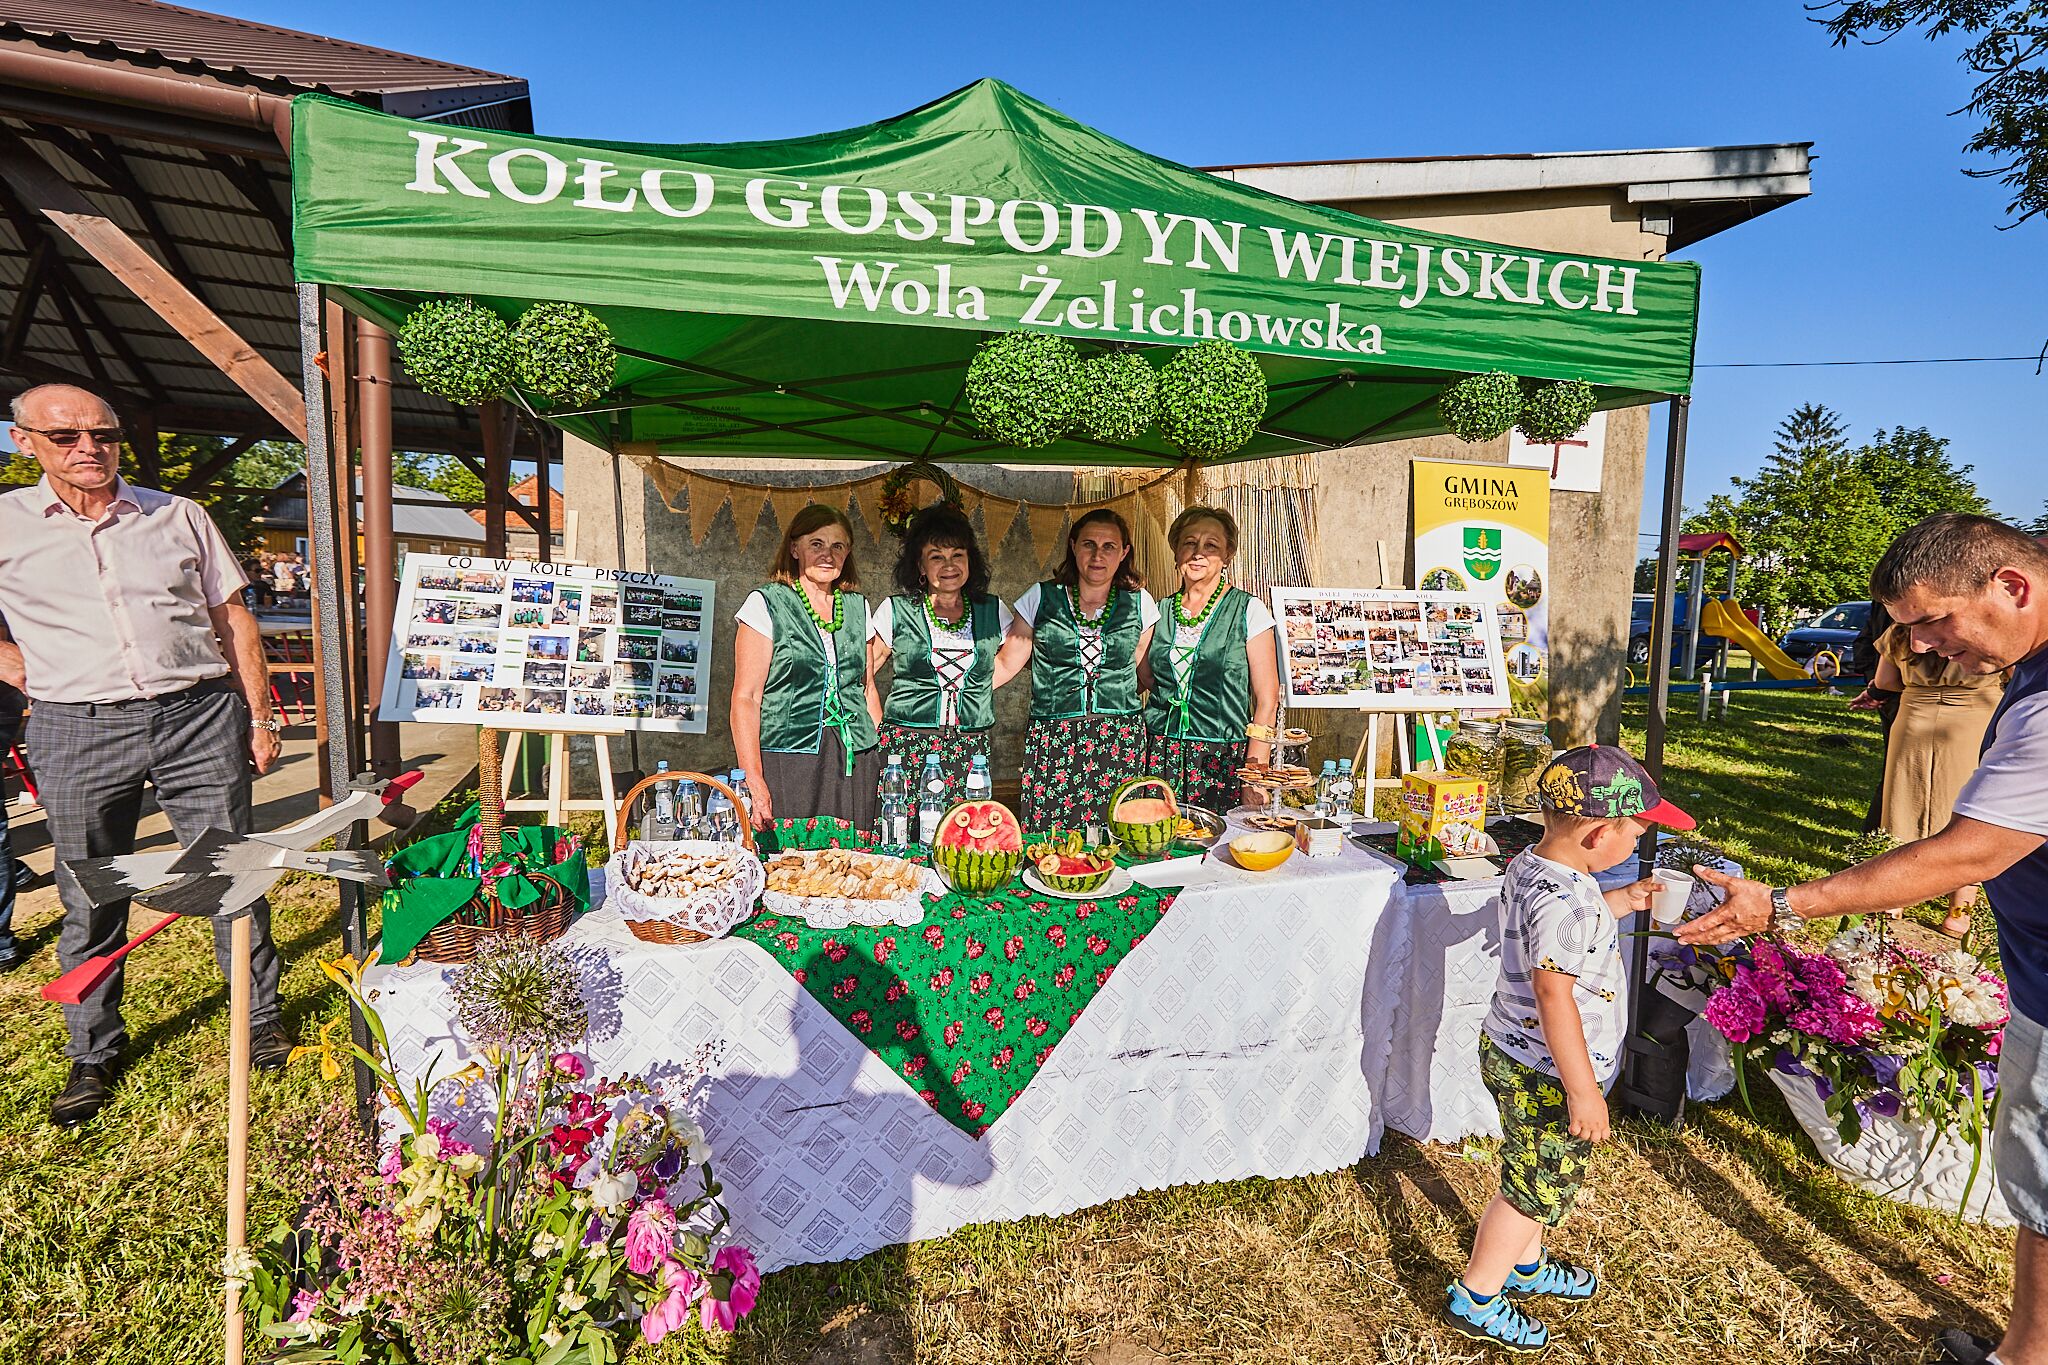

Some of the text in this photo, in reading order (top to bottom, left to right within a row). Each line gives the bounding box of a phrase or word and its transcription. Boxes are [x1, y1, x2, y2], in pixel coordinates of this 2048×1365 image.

[405, 130, 1640, 316] KOŁO GOSPODYN WIEJSKICH
[812, 255, 1386, 355] Wola Żelichowska
[1444, 475, 1519, 497] GMINA
[1444, 496, 1519, 511] GRĘBOSZÓW
[448, 556, 674, 588] CO W KOLE PISZCZY...
